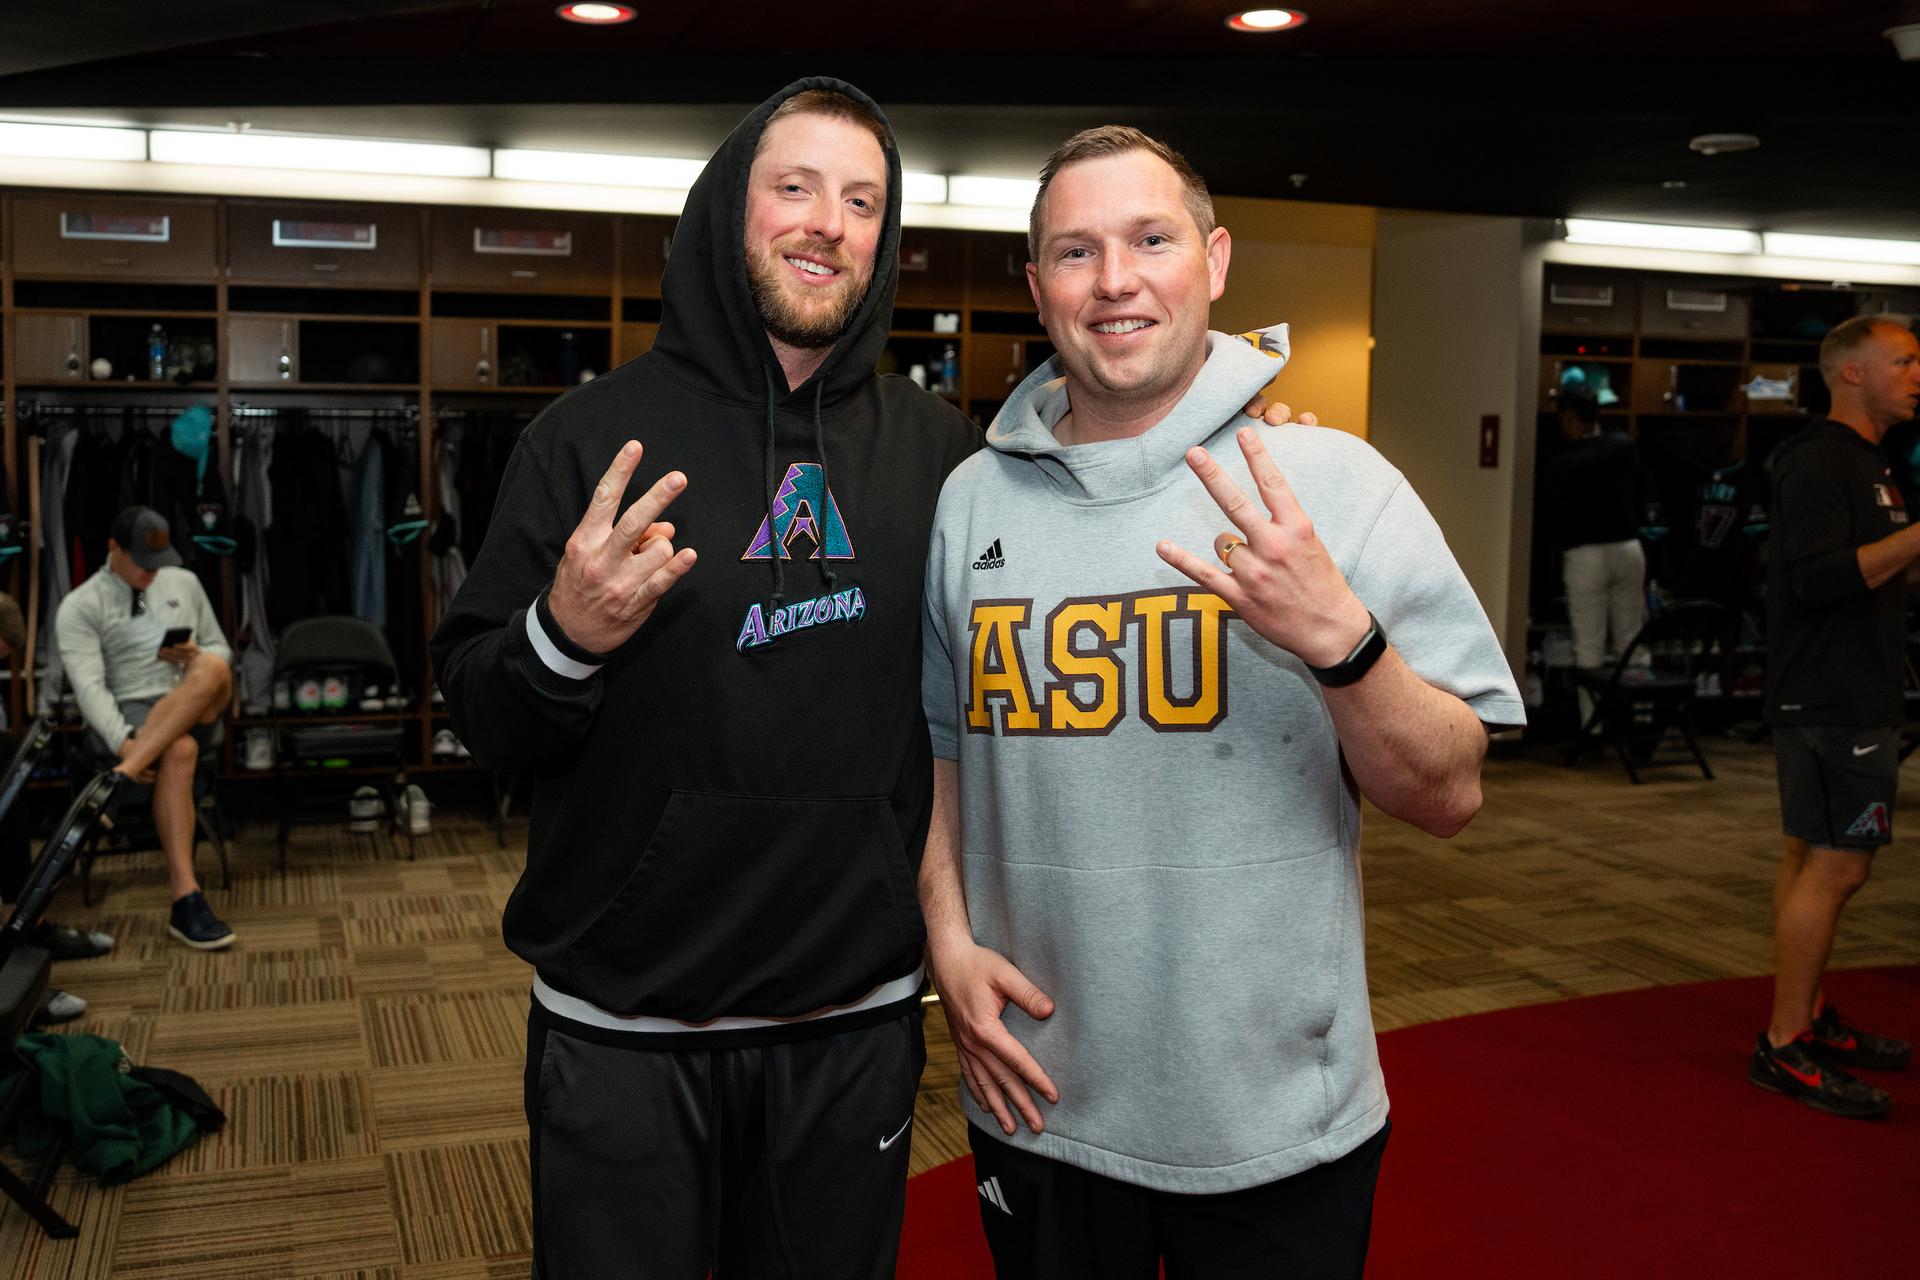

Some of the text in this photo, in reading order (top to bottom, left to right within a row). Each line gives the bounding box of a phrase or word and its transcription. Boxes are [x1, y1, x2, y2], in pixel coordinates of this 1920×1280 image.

[972, 558, 1006, 570] adidas
[737, 586, 867, 652] ARIZONA
[964, 586, 1236, 736] ASU
